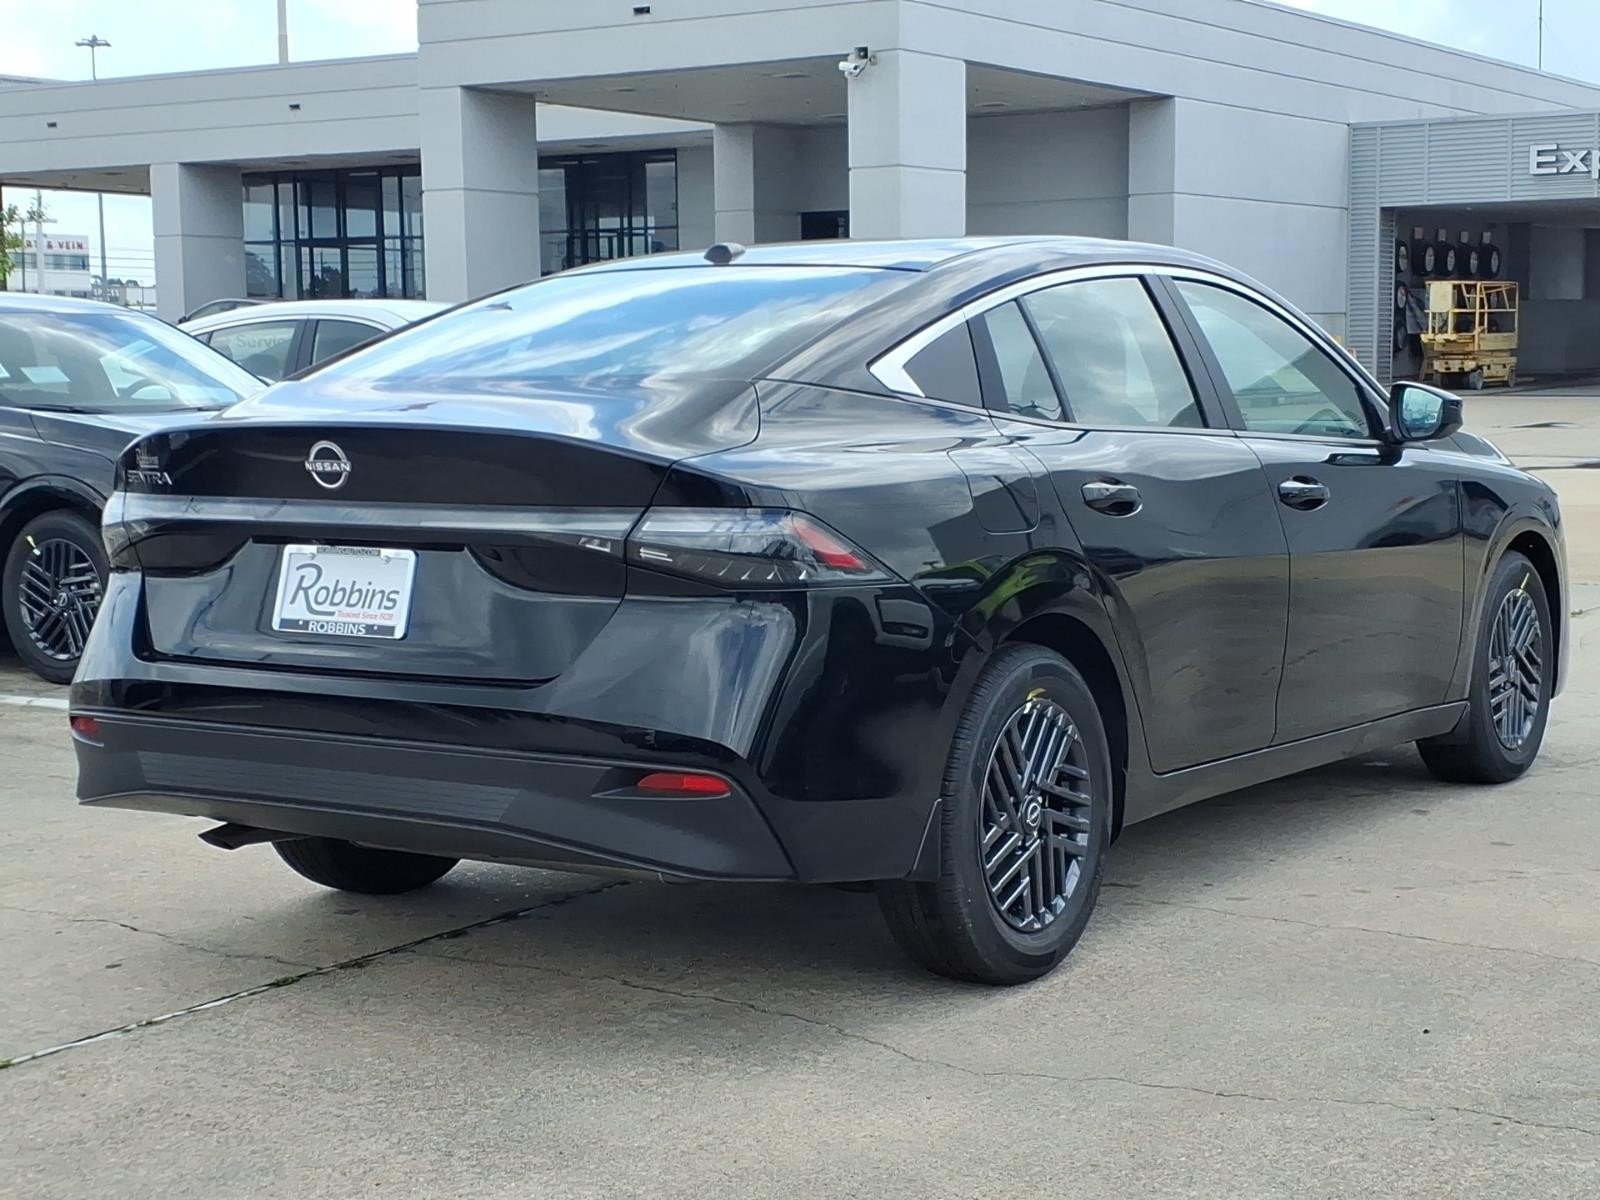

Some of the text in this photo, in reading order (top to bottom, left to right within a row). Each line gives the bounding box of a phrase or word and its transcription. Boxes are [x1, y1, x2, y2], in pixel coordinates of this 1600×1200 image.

[57, 241, 84, 249] VEIN
[304, 461, 351, 472] NISSAN
[289, 563, 400, 616] Robbins
[308, 621, 366, 635] ROBBINS
